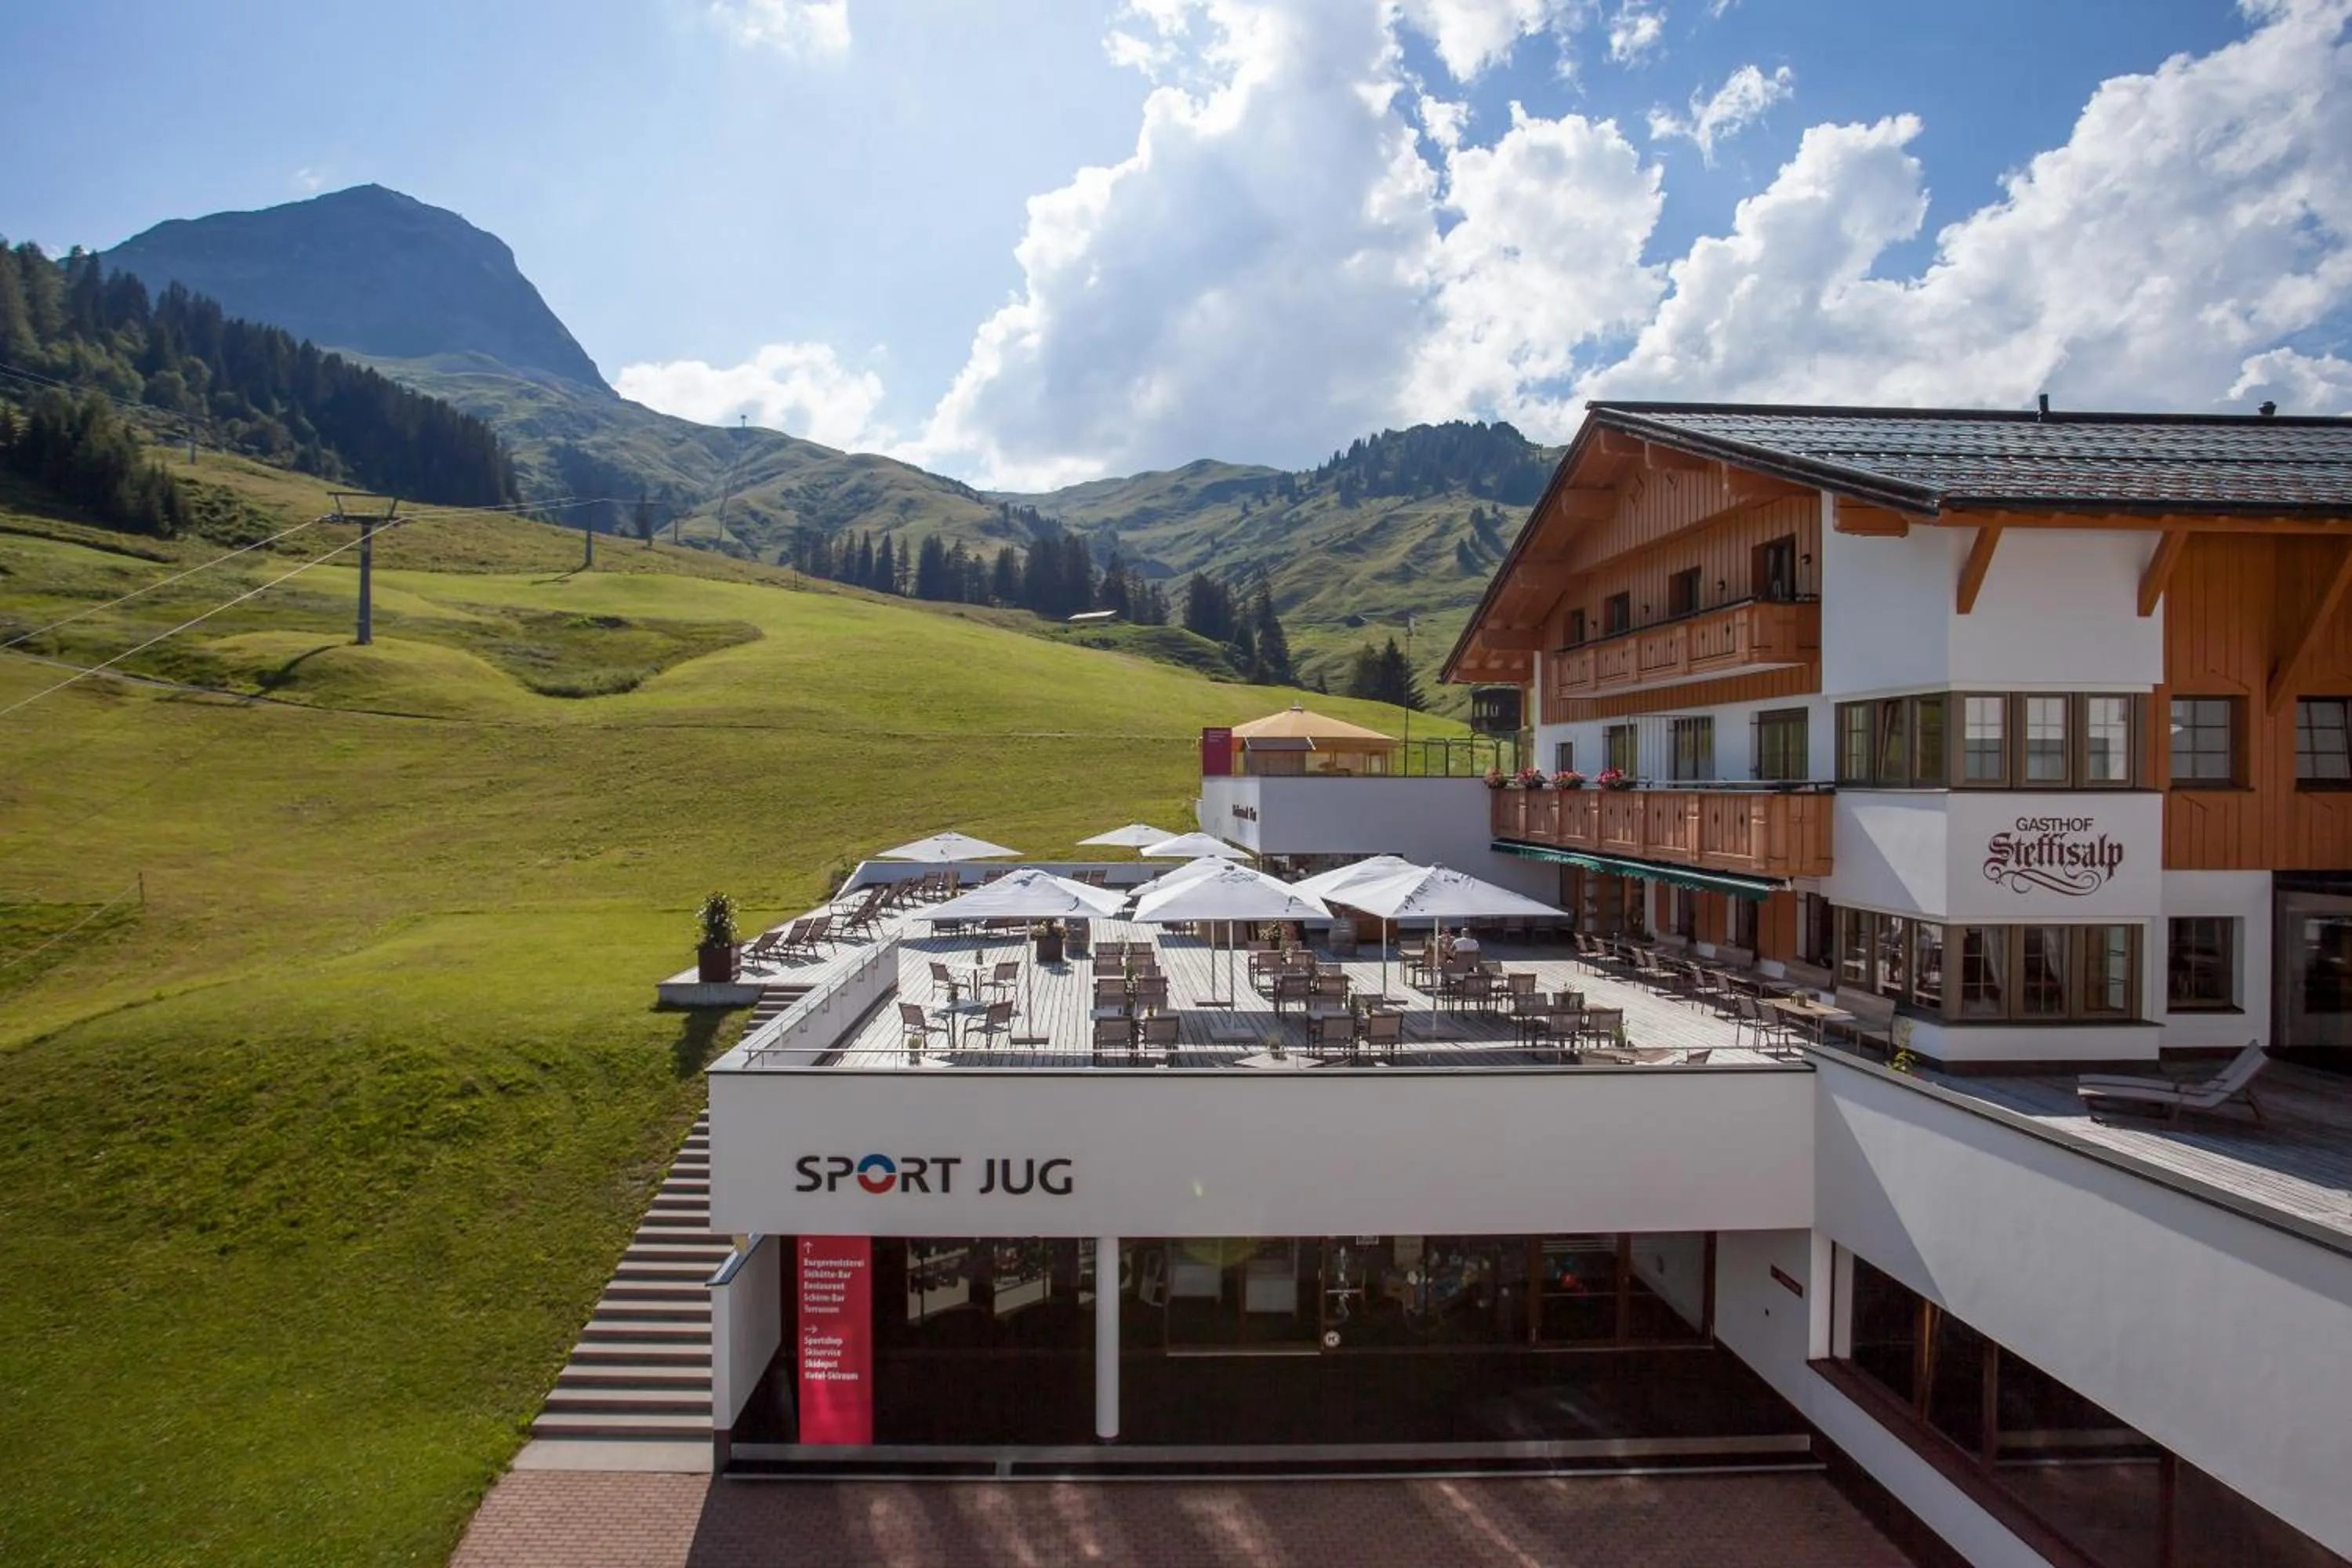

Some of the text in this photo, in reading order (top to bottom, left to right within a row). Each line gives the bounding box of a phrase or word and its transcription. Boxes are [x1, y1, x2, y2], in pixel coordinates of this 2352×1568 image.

[2016, 817, 2094, 832] GASTHOF
[1983, 833, 2124, 883] Steffisalp
[795, 1153, 1073, 1196] SPORT JUG
